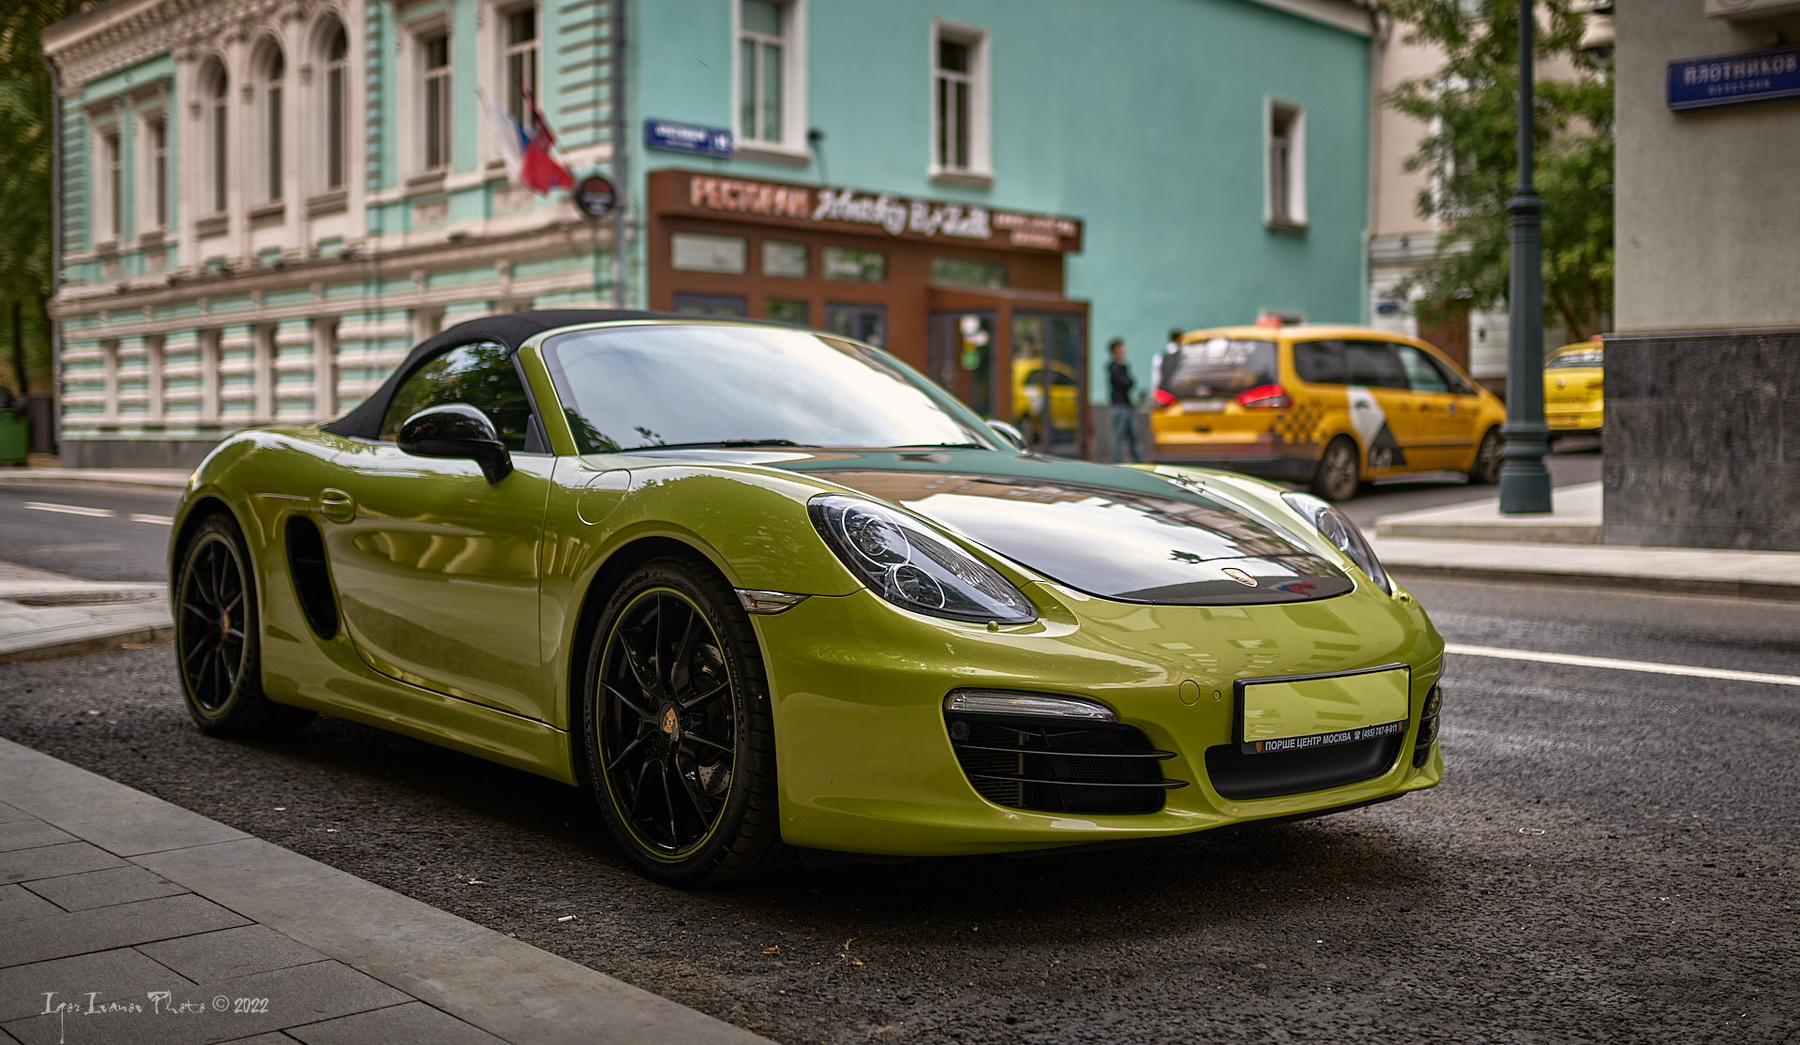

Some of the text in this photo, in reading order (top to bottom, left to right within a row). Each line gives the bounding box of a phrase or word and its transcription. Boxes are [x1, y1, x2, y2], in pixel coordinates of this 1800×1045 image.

[1684, 53, 1797, 86] ПЛОТНИКОВ
[1265, 739, 1295, 751] ПОРШЕ
[1296, 736, 1322, 749] ЦЕНТР
[1322, 732, 1352, 745] МОСКВА
[1361, 727, 1375, 740] (495)
